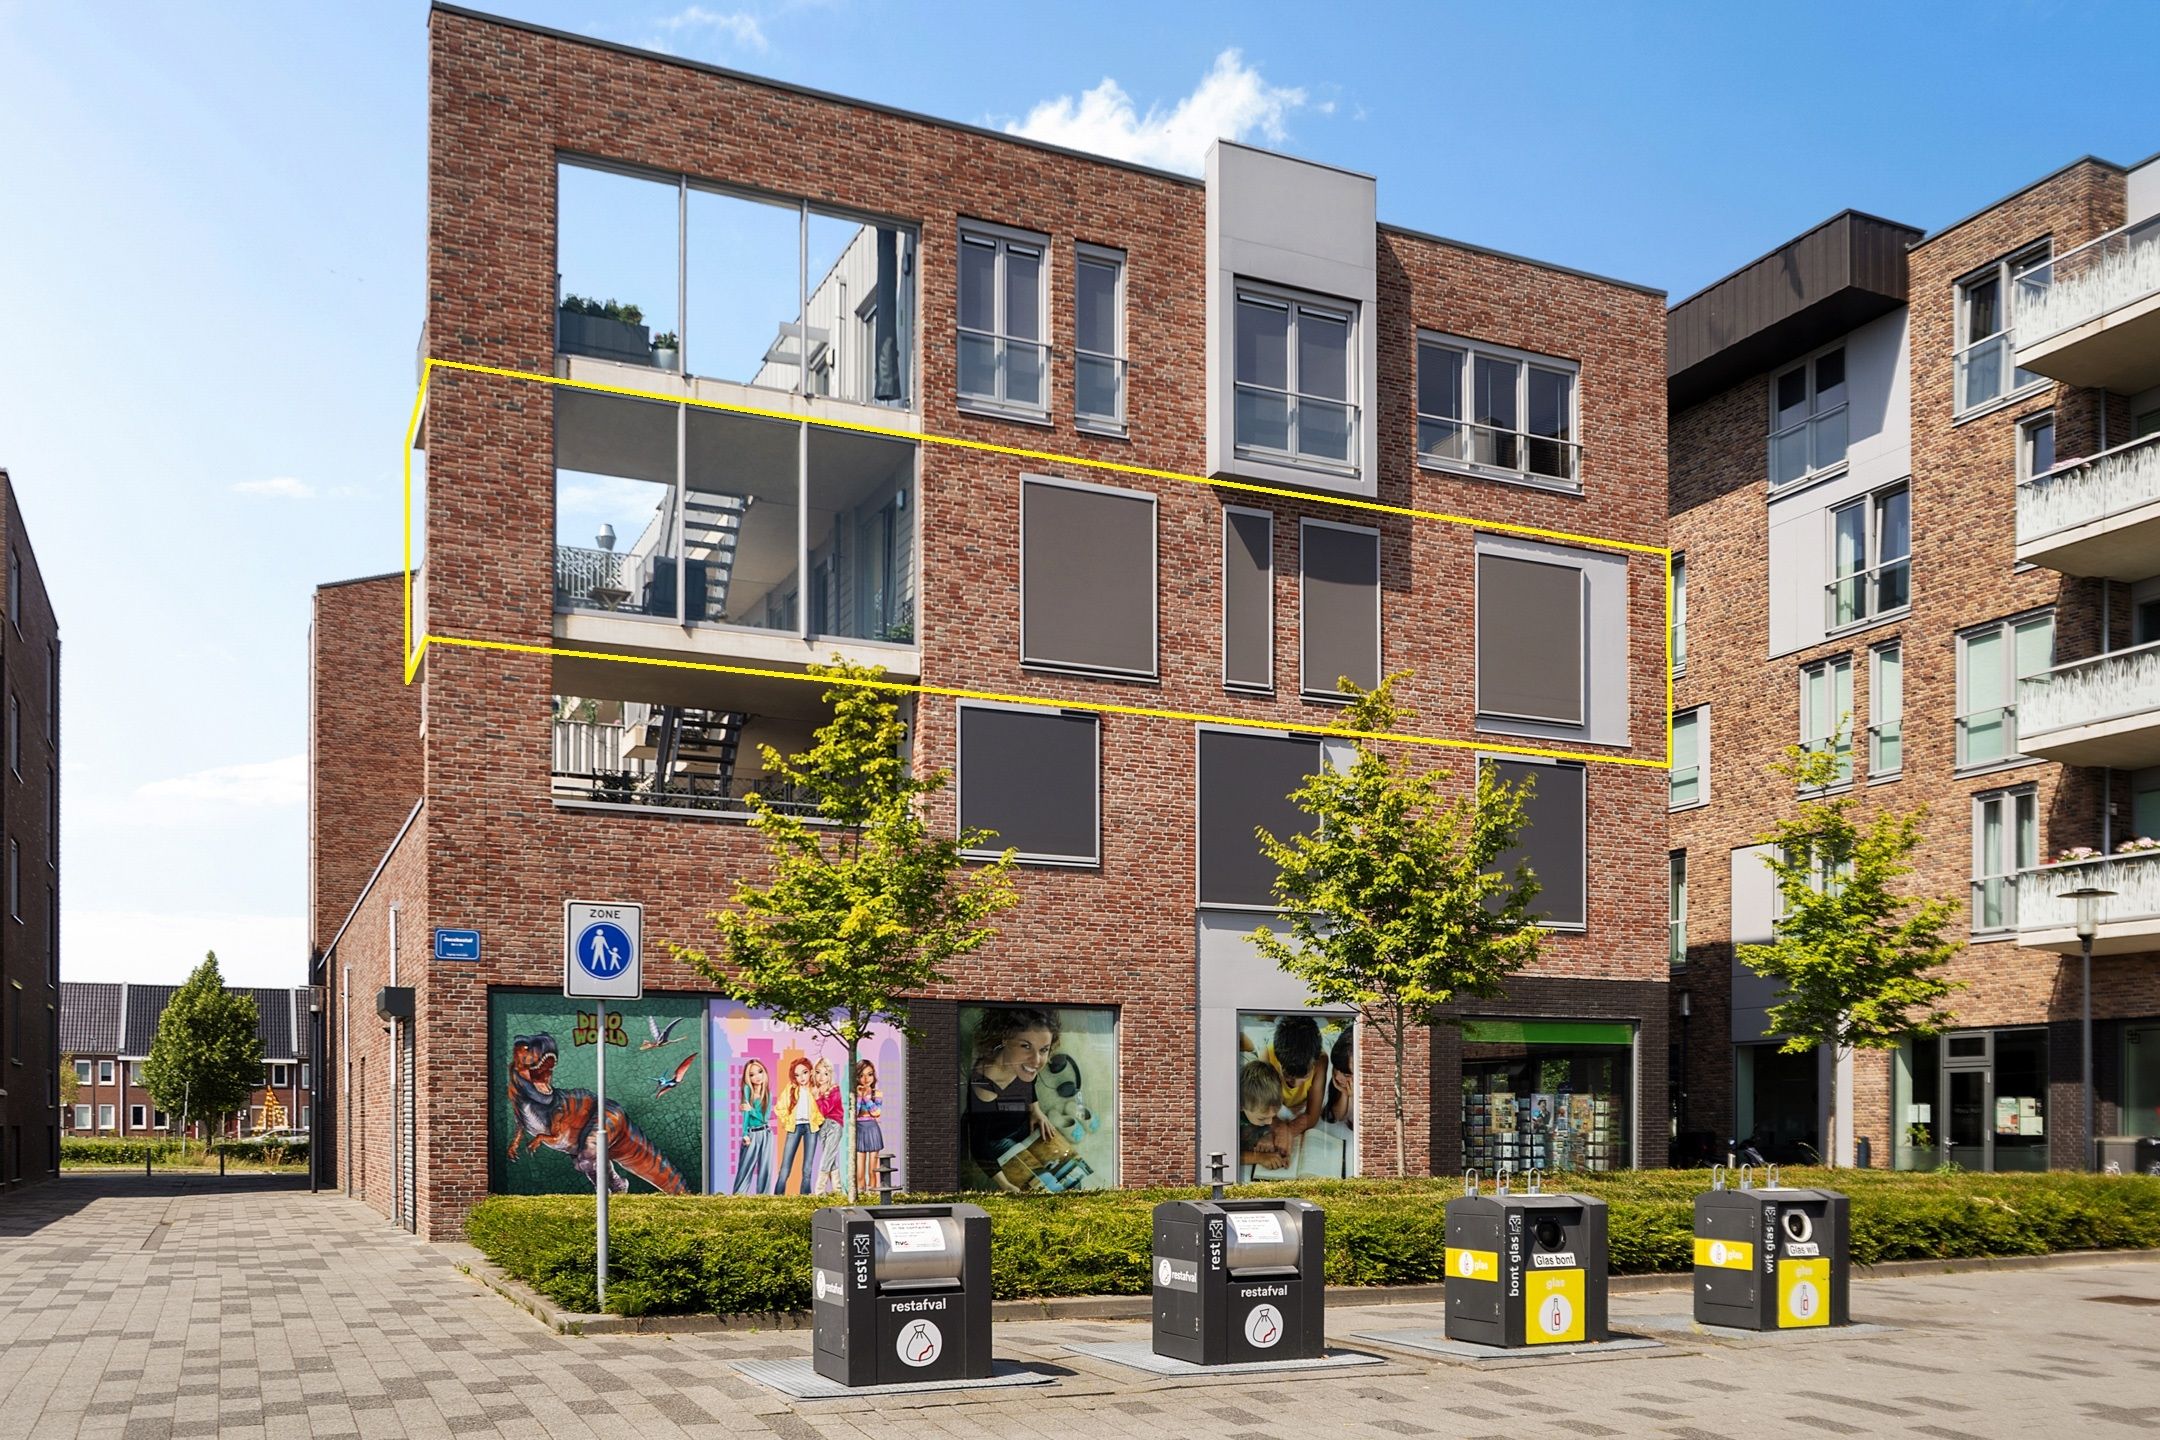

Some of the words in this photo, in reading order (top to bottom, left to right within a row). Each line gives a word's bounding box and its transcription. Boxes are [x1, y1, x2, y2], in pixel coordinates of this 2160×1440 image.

[590, 909, 621, 919] ZONE
[1765, 1226, 1776, 1251] glas
[1210, 1242, 1221, 1270] rest
[1509, 1236, 1521, 1263] glas
[1790, 1245, 1806, 1255] Glas
[1536, 1255, 1554, 1265] Glas
[1555, 1254, 1574, 1265] bont
[1765, 1254, 1774, 1274] wit
[854, 1259, 867, 1289] rest
[1171, 1270, 1197, 1283] restafval
[1509, 1266, 1519, 1297] bont
[1546, 1276, 1565, 1290] glas
[1241, 1284, 1287, 1297] restafval
[891, 1298, 946, 1312] restafval
